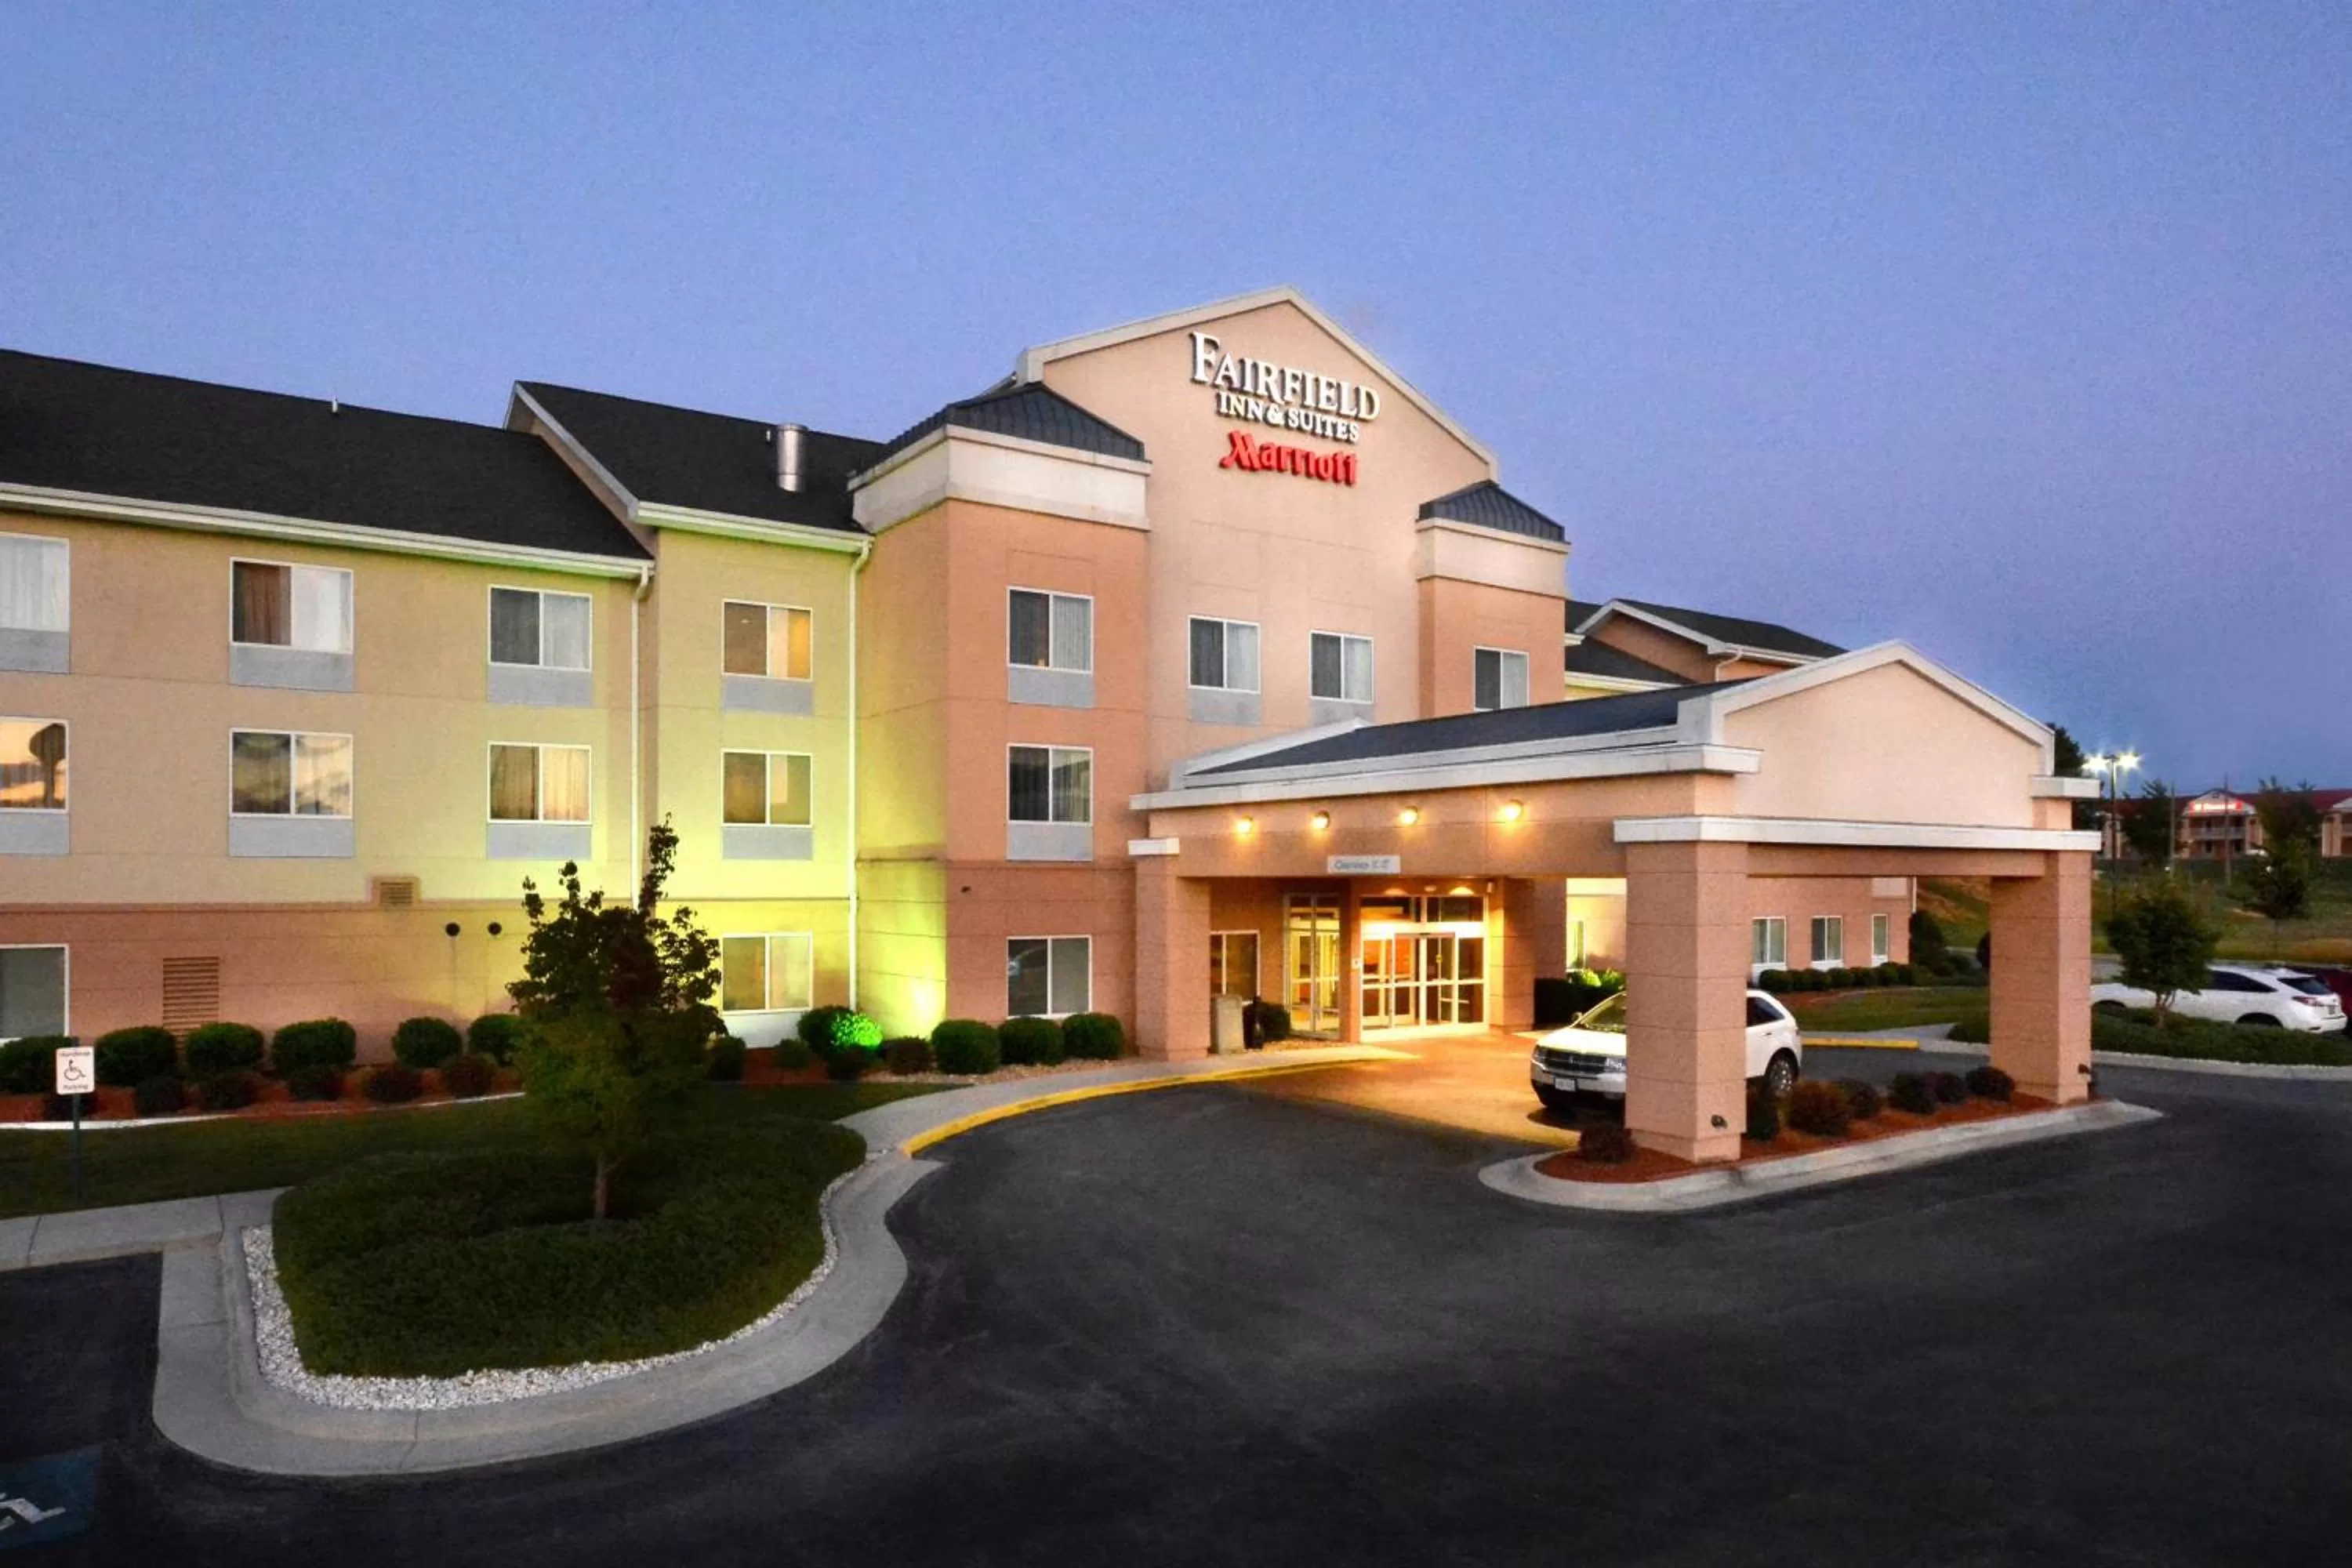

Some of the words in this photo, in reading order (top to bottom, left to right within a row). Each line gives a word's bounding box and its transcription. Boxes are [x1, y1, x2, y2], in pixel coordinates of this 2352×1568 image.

[1190, 331, 1381, 422] FAIRFIELD
[1216, 391, 1263, 424] INN
[1287, 407, 1360, 443] SUITES
[1219, 430, 1357, 486] Marriott
